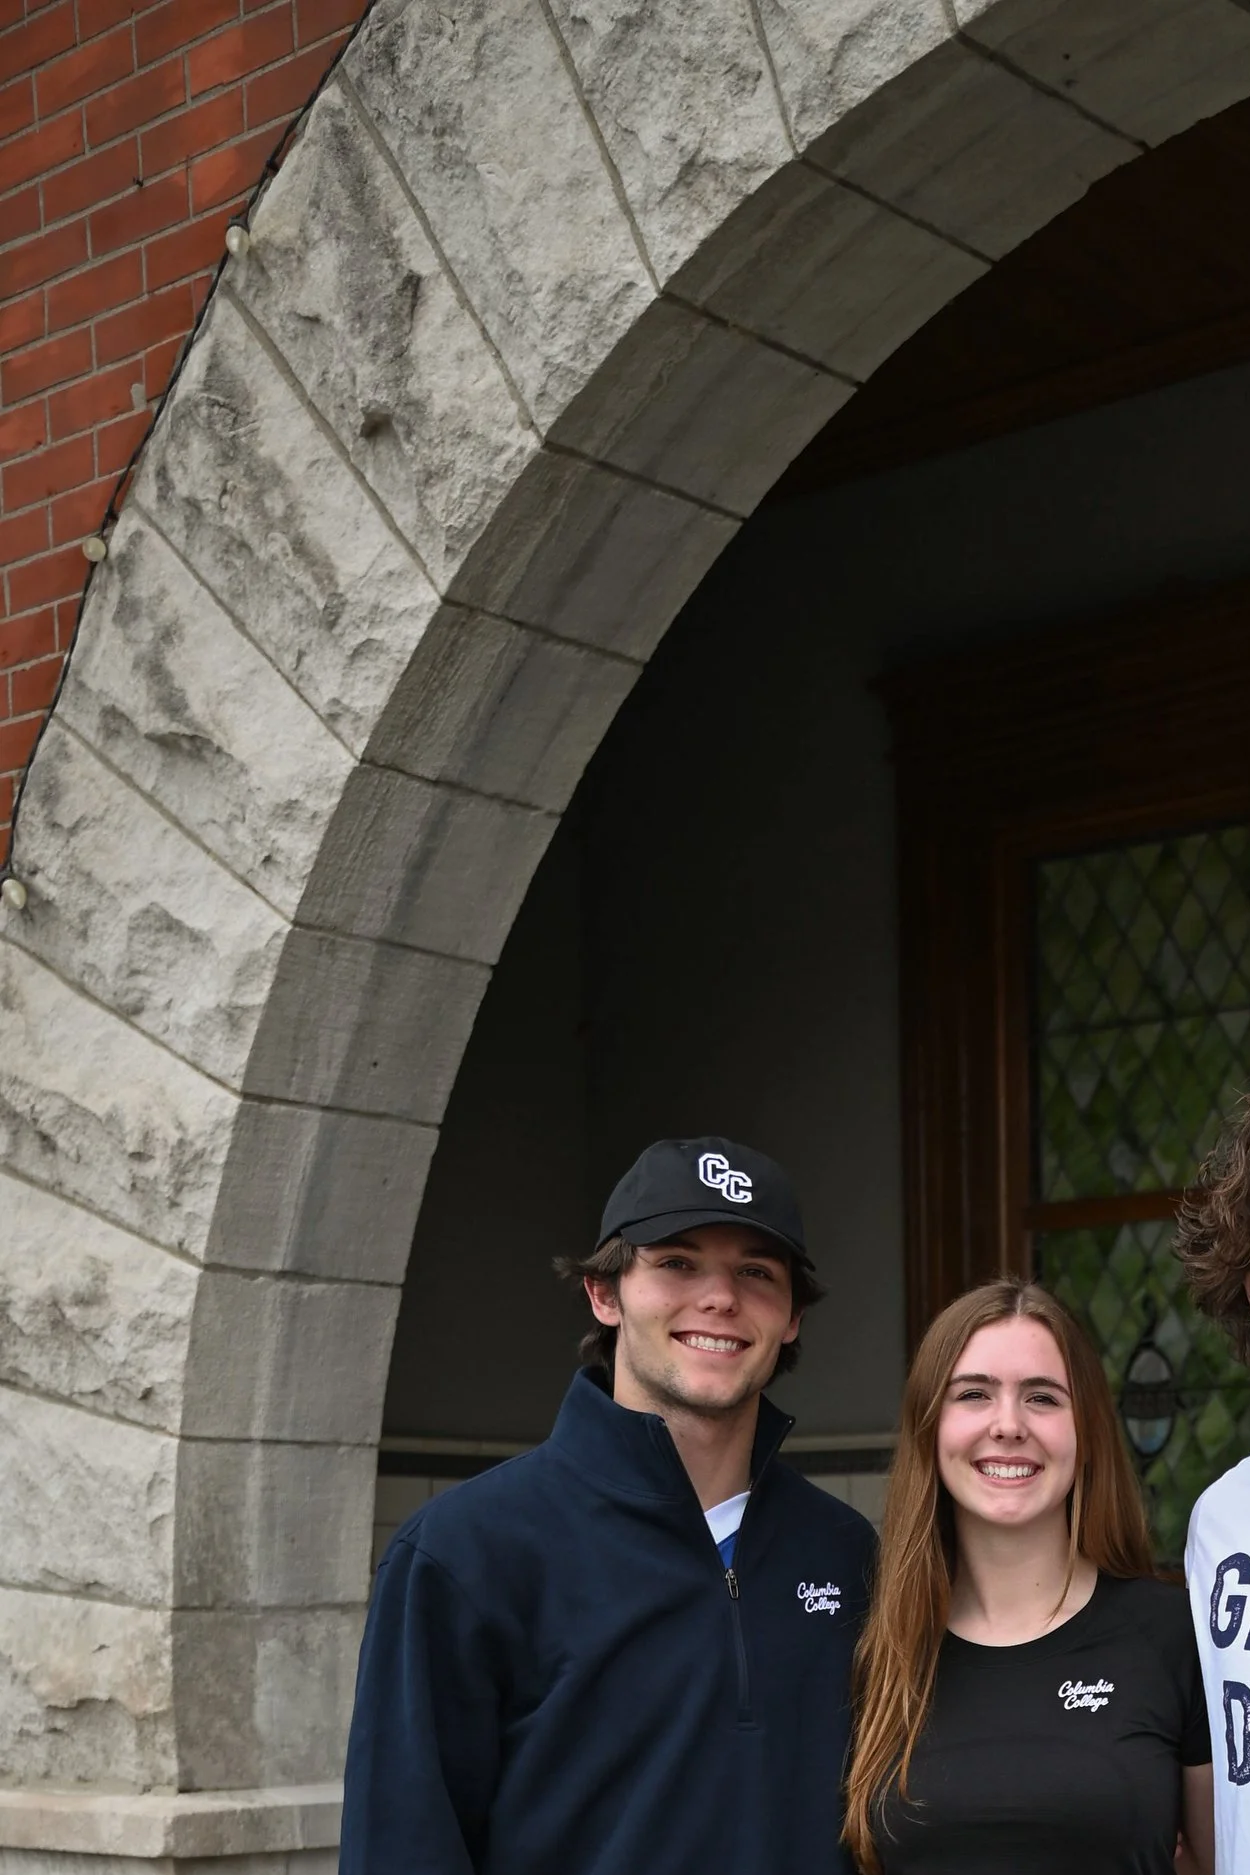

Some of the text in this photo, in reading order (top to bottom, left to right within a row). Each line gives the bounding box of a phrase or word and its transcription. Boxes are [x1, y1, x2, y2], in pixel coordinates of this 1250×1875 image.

[699, 1153, 753, 1203] CC
[797, 1582, 841, 1599] Columbia
[804, 1597, 841, 1615] College
[1058, 1679, 1115, 1698] Columbia
[1064, 1694, 1109, 1712] College
